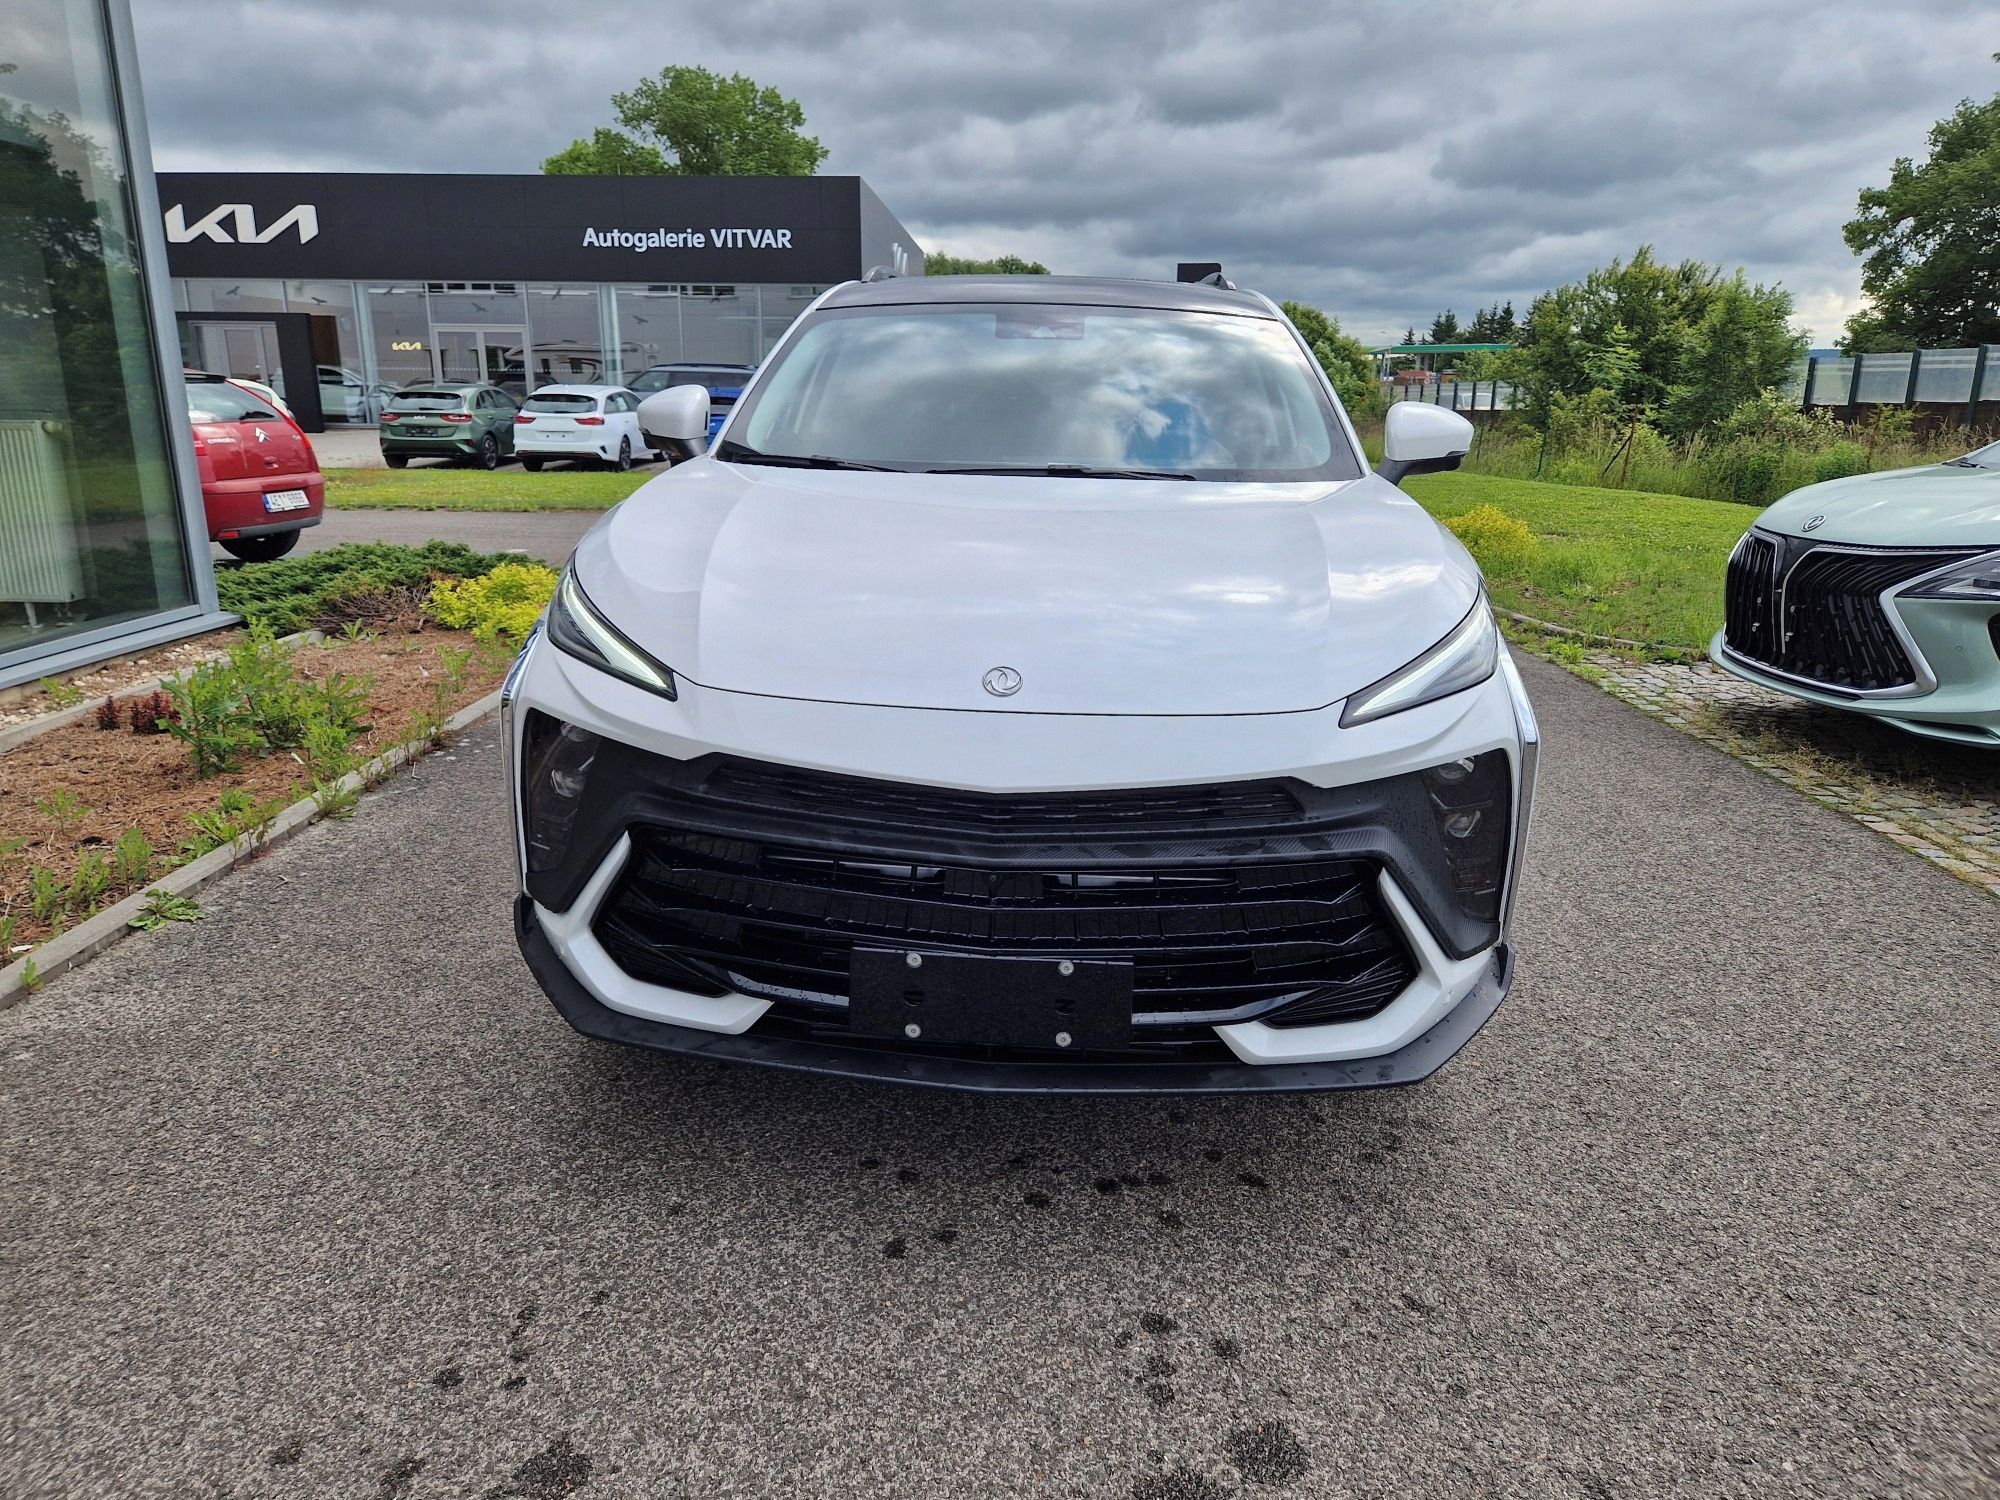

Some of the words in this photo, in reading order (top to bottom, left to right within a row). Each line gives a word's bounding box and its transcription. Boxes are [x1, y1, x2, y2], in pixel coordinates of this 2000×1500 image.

[164, 203, 319, 244] KIA
[582, 227, 706, 253] Autogalerie
[709, 228, 793, 249] VITVAR
